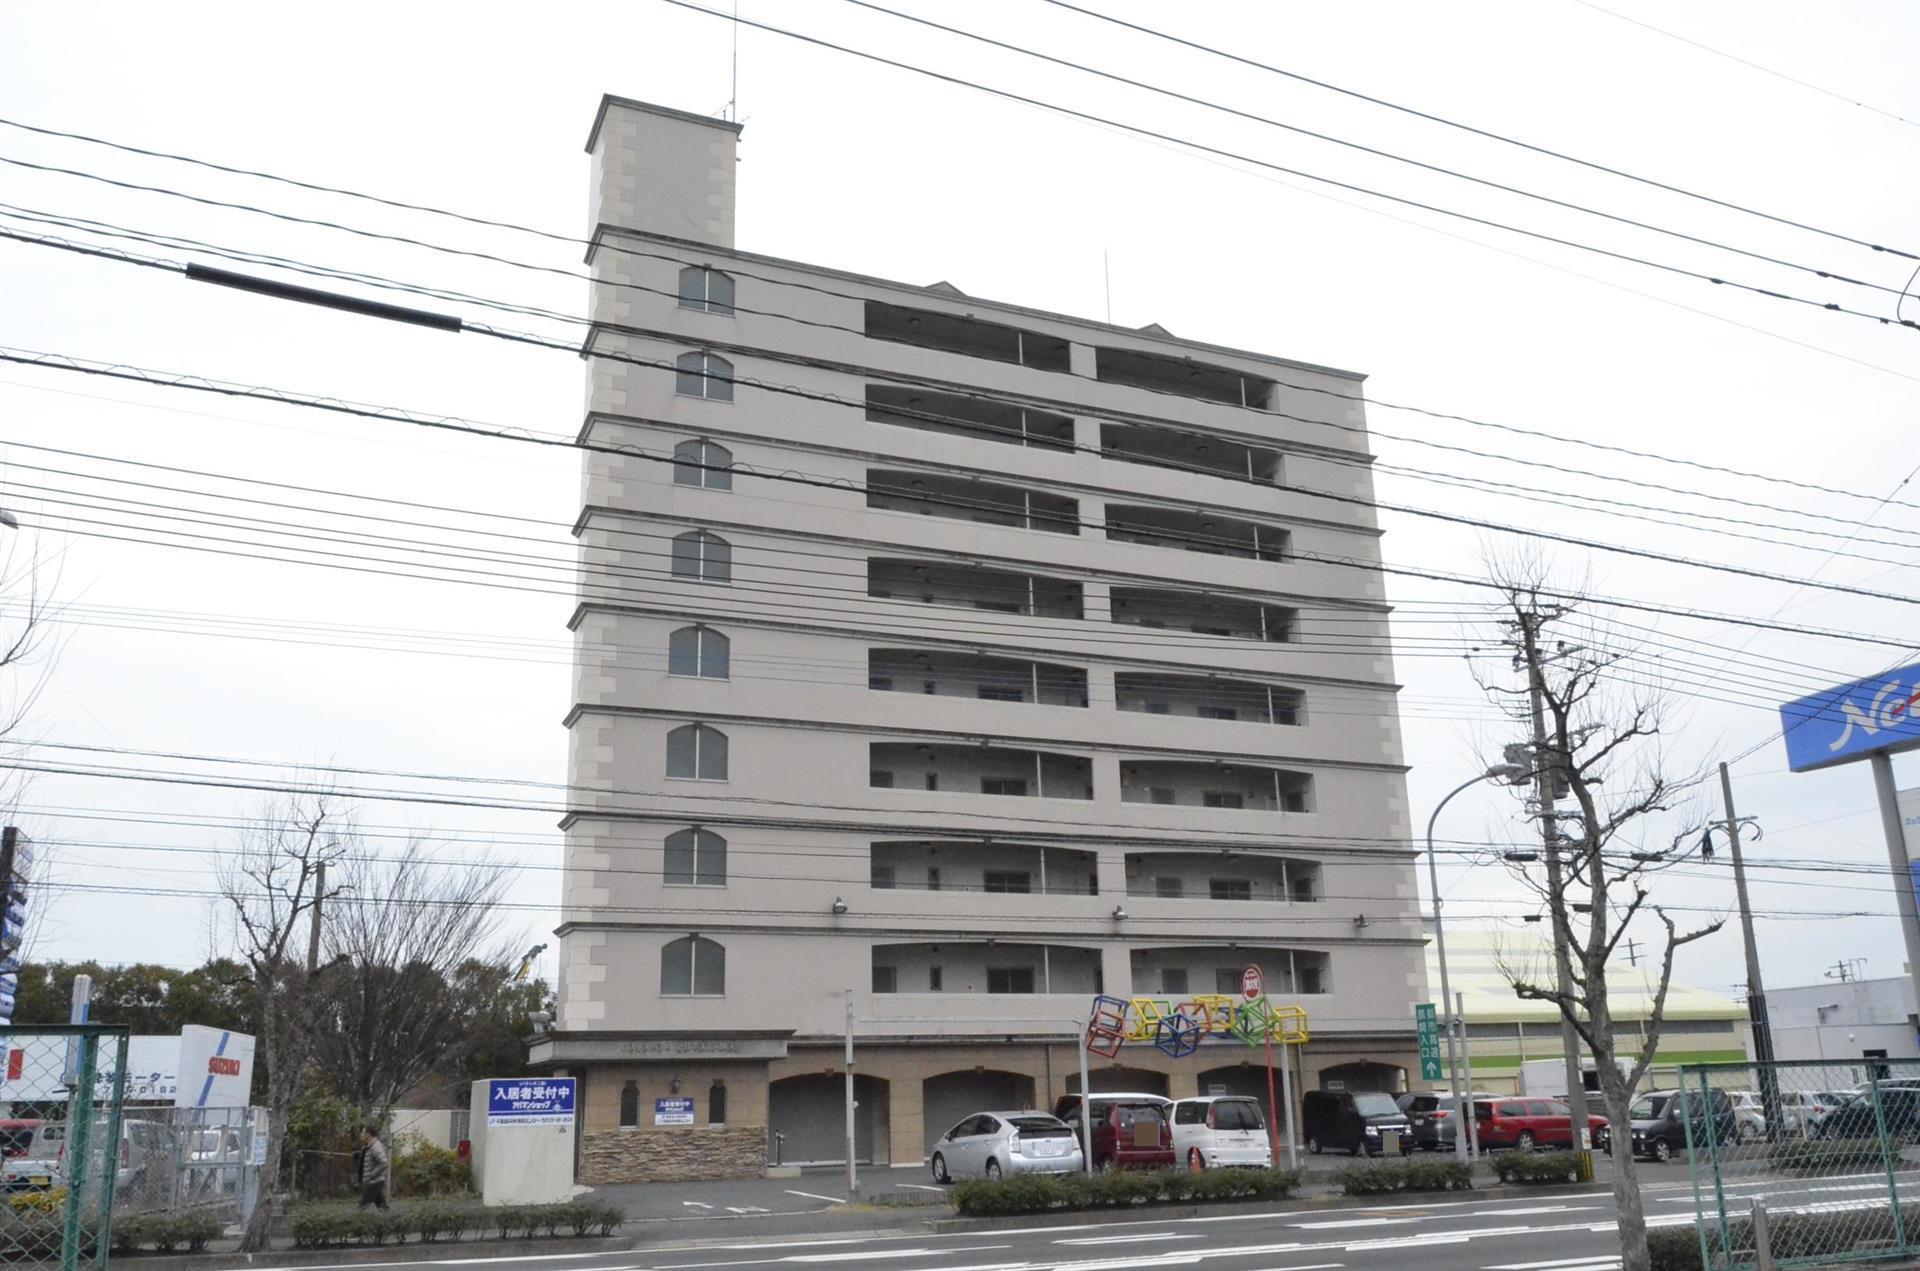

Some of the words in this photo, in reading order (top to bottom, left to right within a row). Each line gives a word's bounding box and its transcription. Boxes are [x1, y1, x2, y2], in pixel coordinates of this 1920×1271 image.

[208, 1056, 241, 1076] SUZUKI
[494, 1086, 570, 1100] 入居者受付中
[512, 1100, 552, 1110] アパマンショップ
